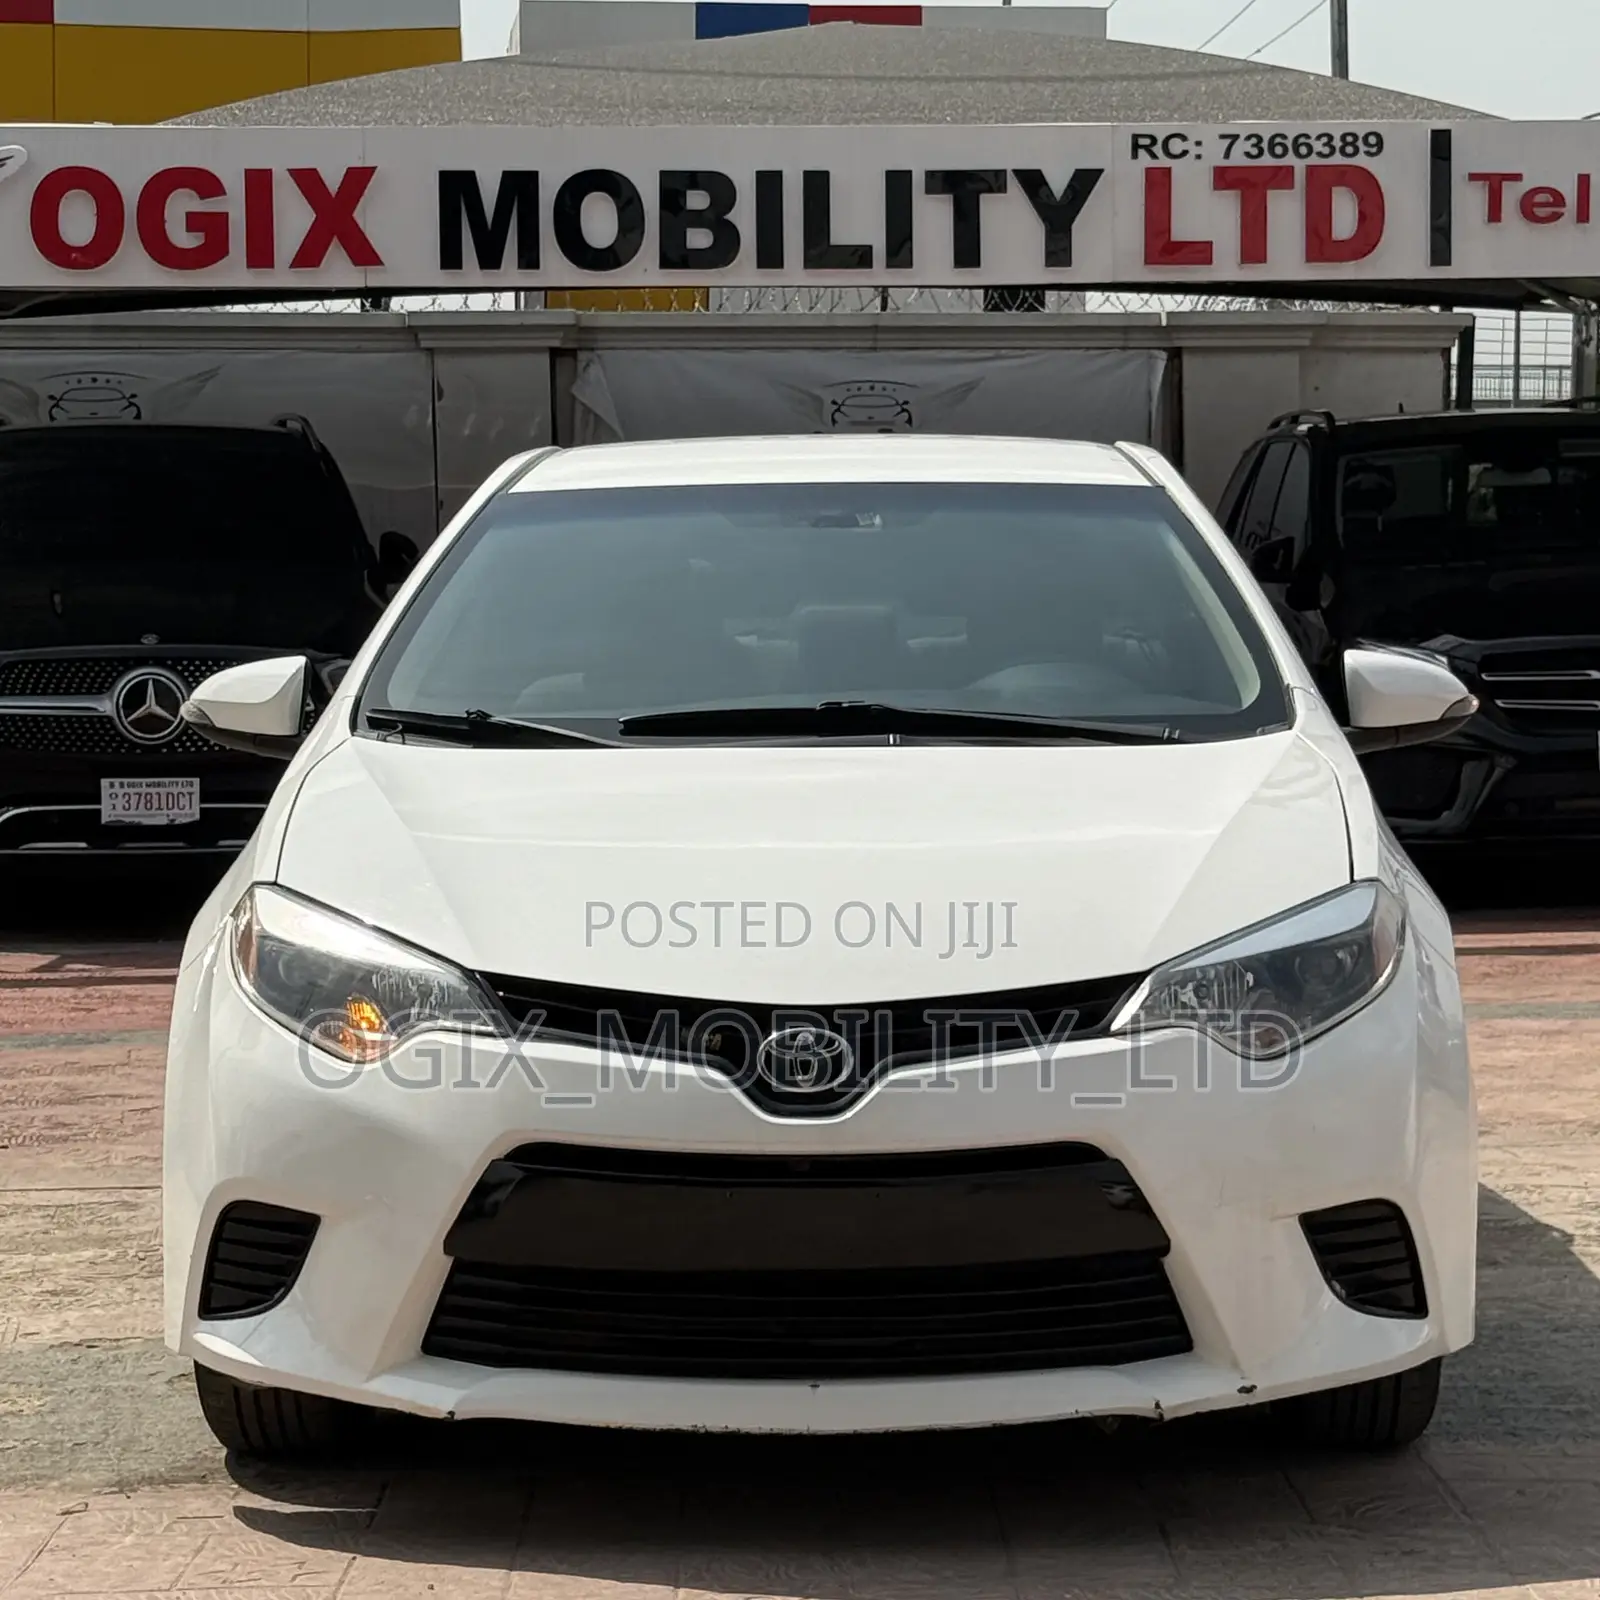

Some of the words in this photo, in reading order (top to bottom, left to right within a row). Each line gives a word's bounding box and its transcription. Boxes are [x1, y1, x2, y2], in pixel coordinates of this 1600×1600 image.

[1130, 132, 1203, 160] RC:
[1218, 131, 1384, 160] 7366389
[30, 165, 384, 271] OGIX
[438, 168, 1105, 270] MOBILITY
[1144, 164, 1385, 265] LTD
[1468, 172, 1591, 224] Tel
[122, 791, 195, 811] 3781DCT
